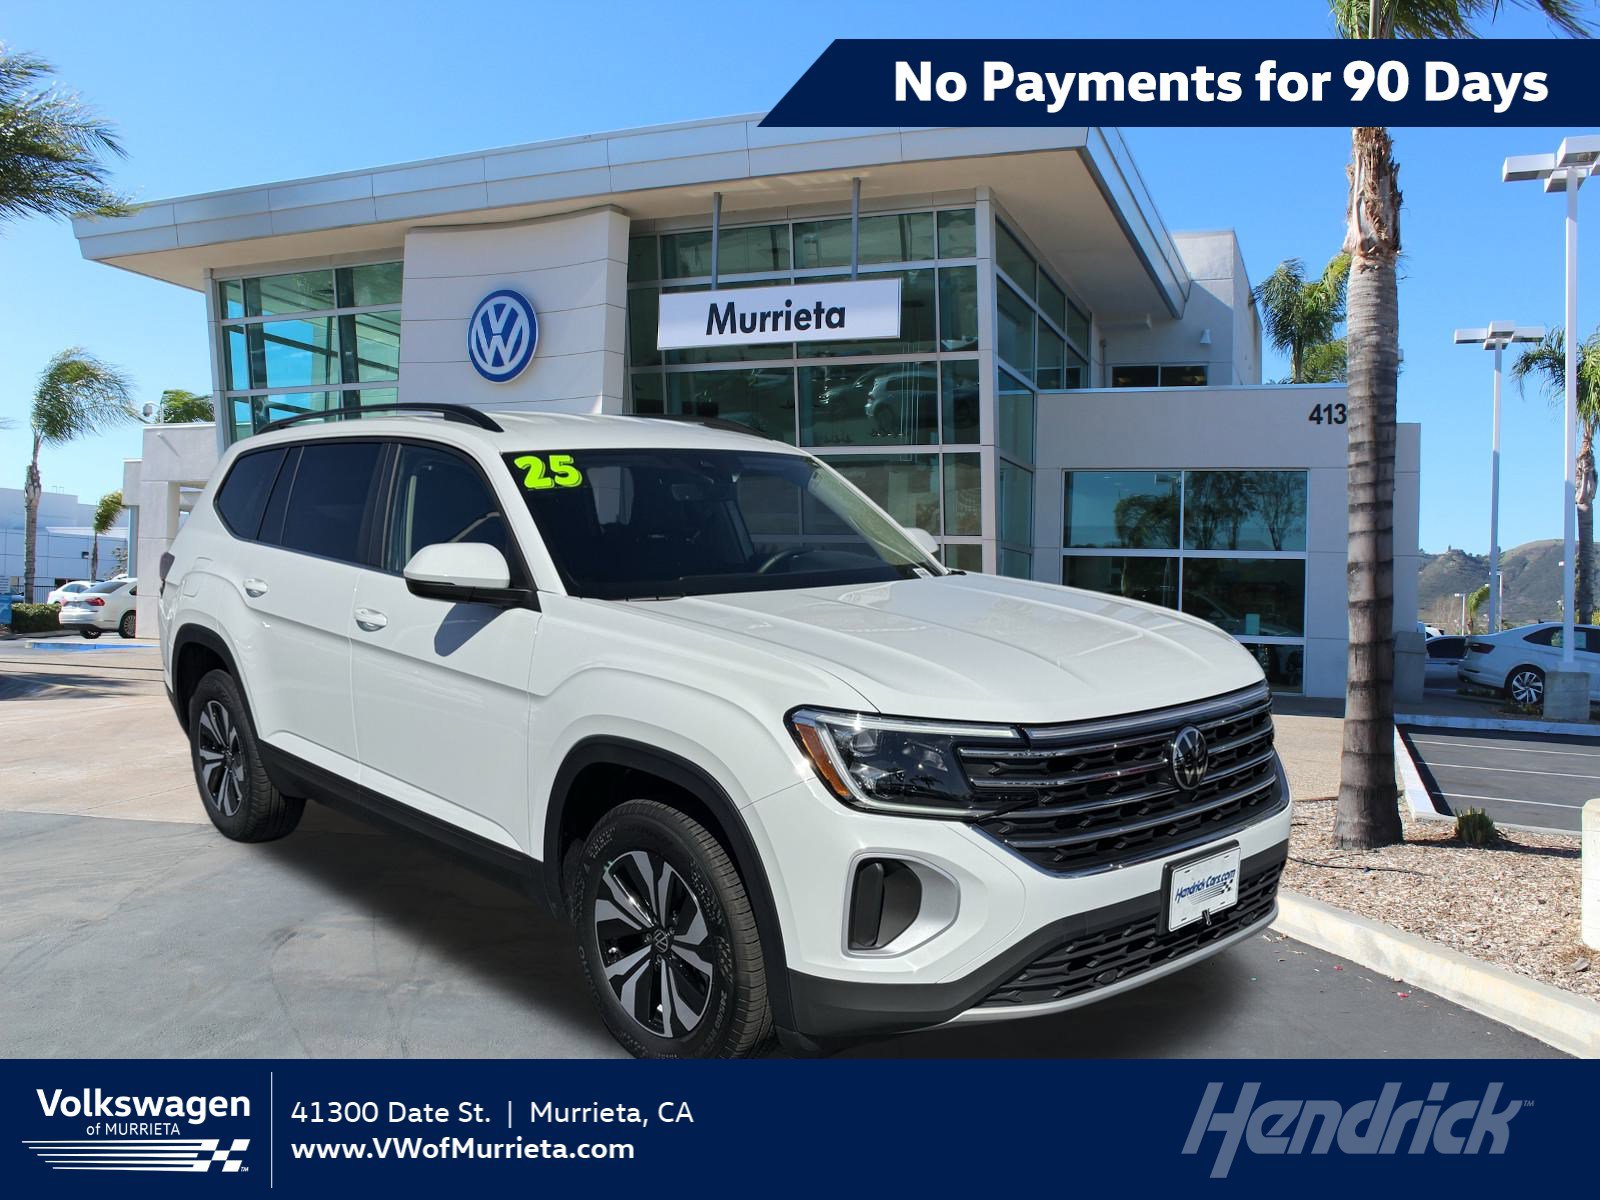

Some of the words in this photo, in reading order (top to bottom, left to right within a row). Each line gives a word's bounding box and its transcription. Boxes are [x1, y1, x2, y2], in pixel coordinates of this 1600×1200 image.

[705, 299, 846, 336] Murrieta
[1308, 403, 1347, 425] 413
[513, 454, 583, 489] 25
